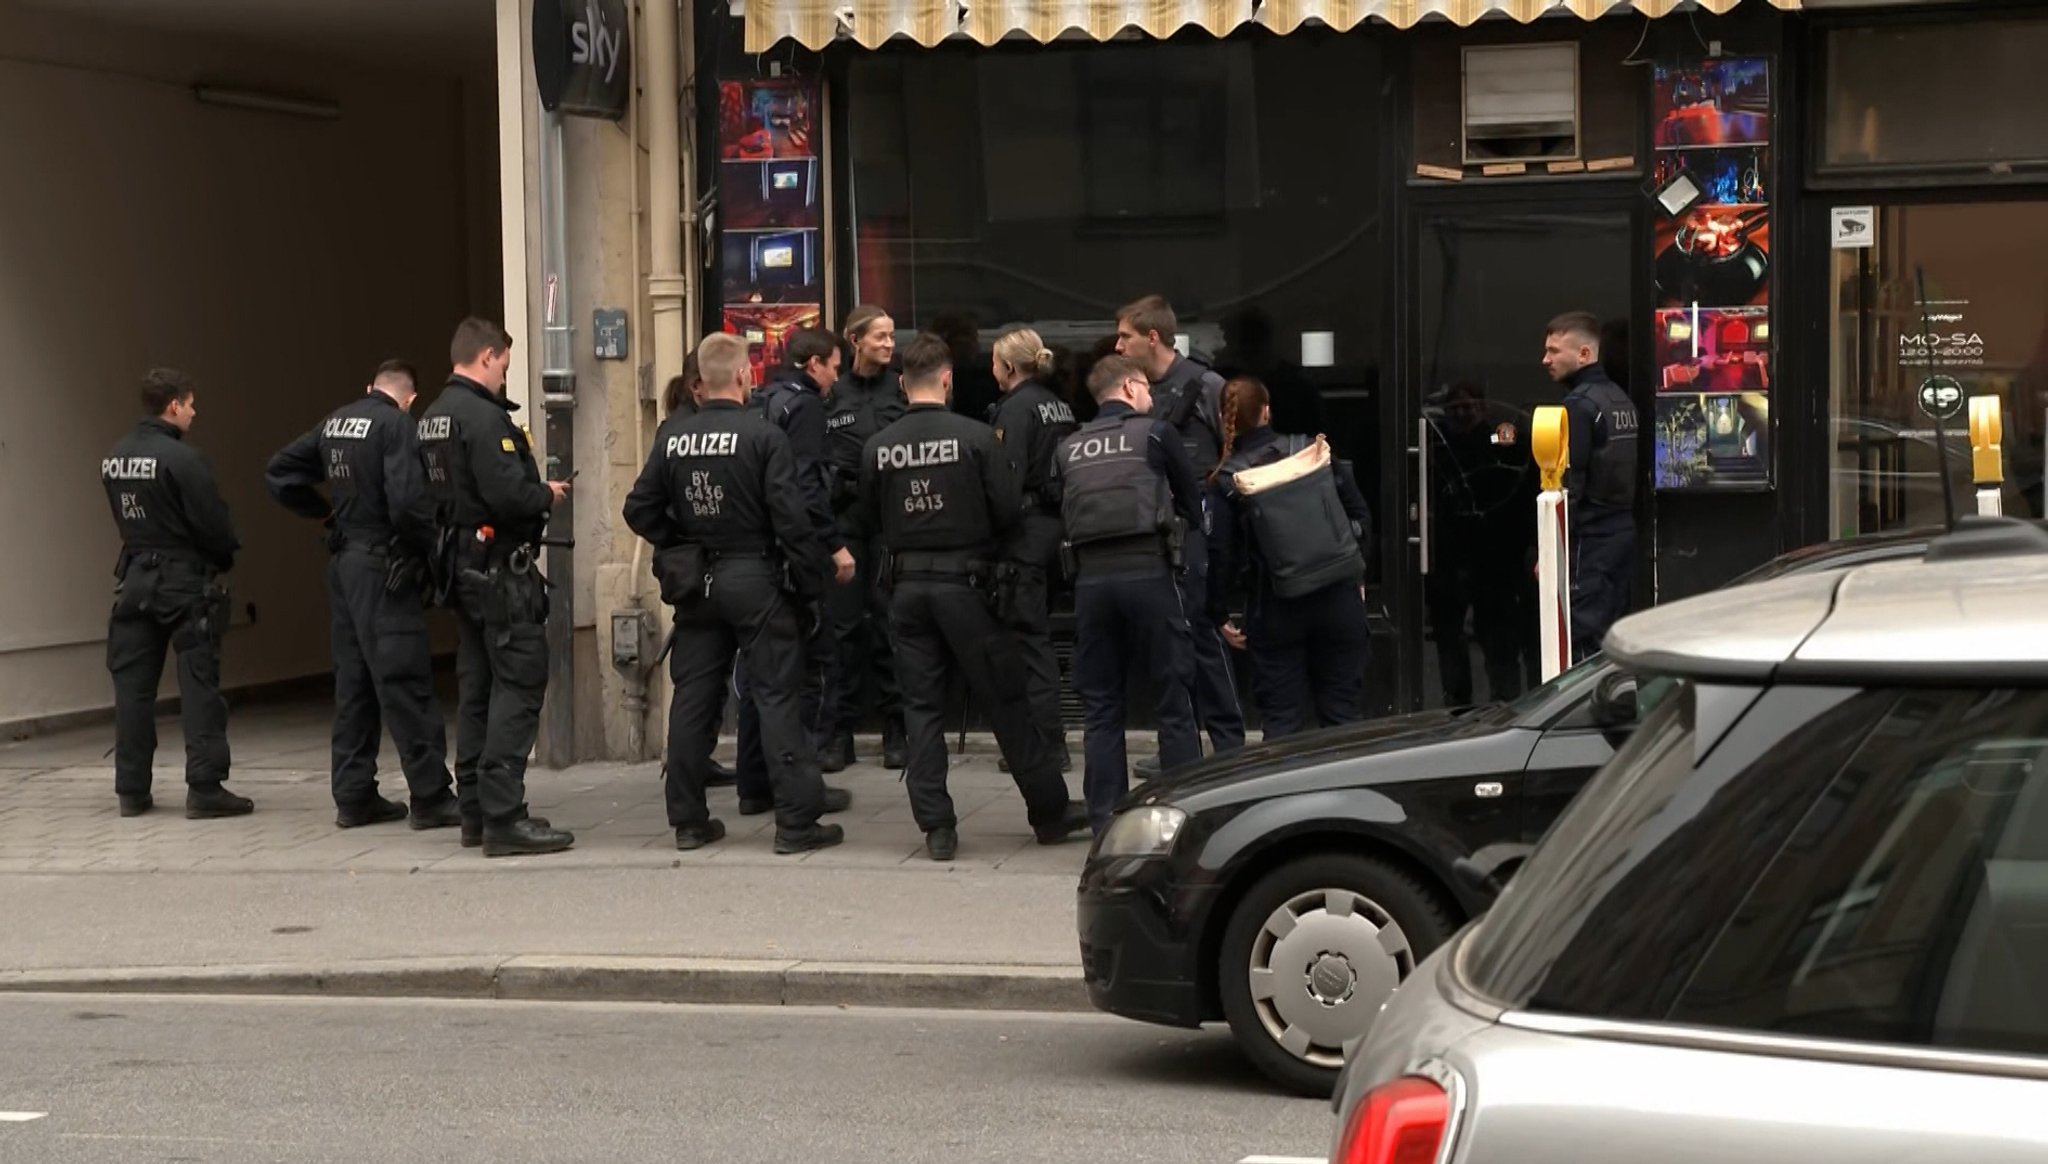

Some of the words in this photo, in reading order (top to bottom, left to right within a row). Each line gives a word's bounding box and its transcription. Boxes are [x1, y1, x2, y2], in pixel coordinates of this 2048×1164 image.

[572, 4, 621, 83] sky
[1900, 333, 1984, 346] MO-SA
[1612, 410, 1639, 430] ZOLL
[666, 433, 739, 459] POLIZEI
[877, 438, 959, 471] POLIZEI
[1068, 435, 1134, 462] ZOLL
[101, 457, 157, 480] POLIZEI
[692, 470, 710, 487] BY
[911, 479, 930, 495] BY
[121, 492, 136, 506] BY
[904, 494, 944, 512] 6413
